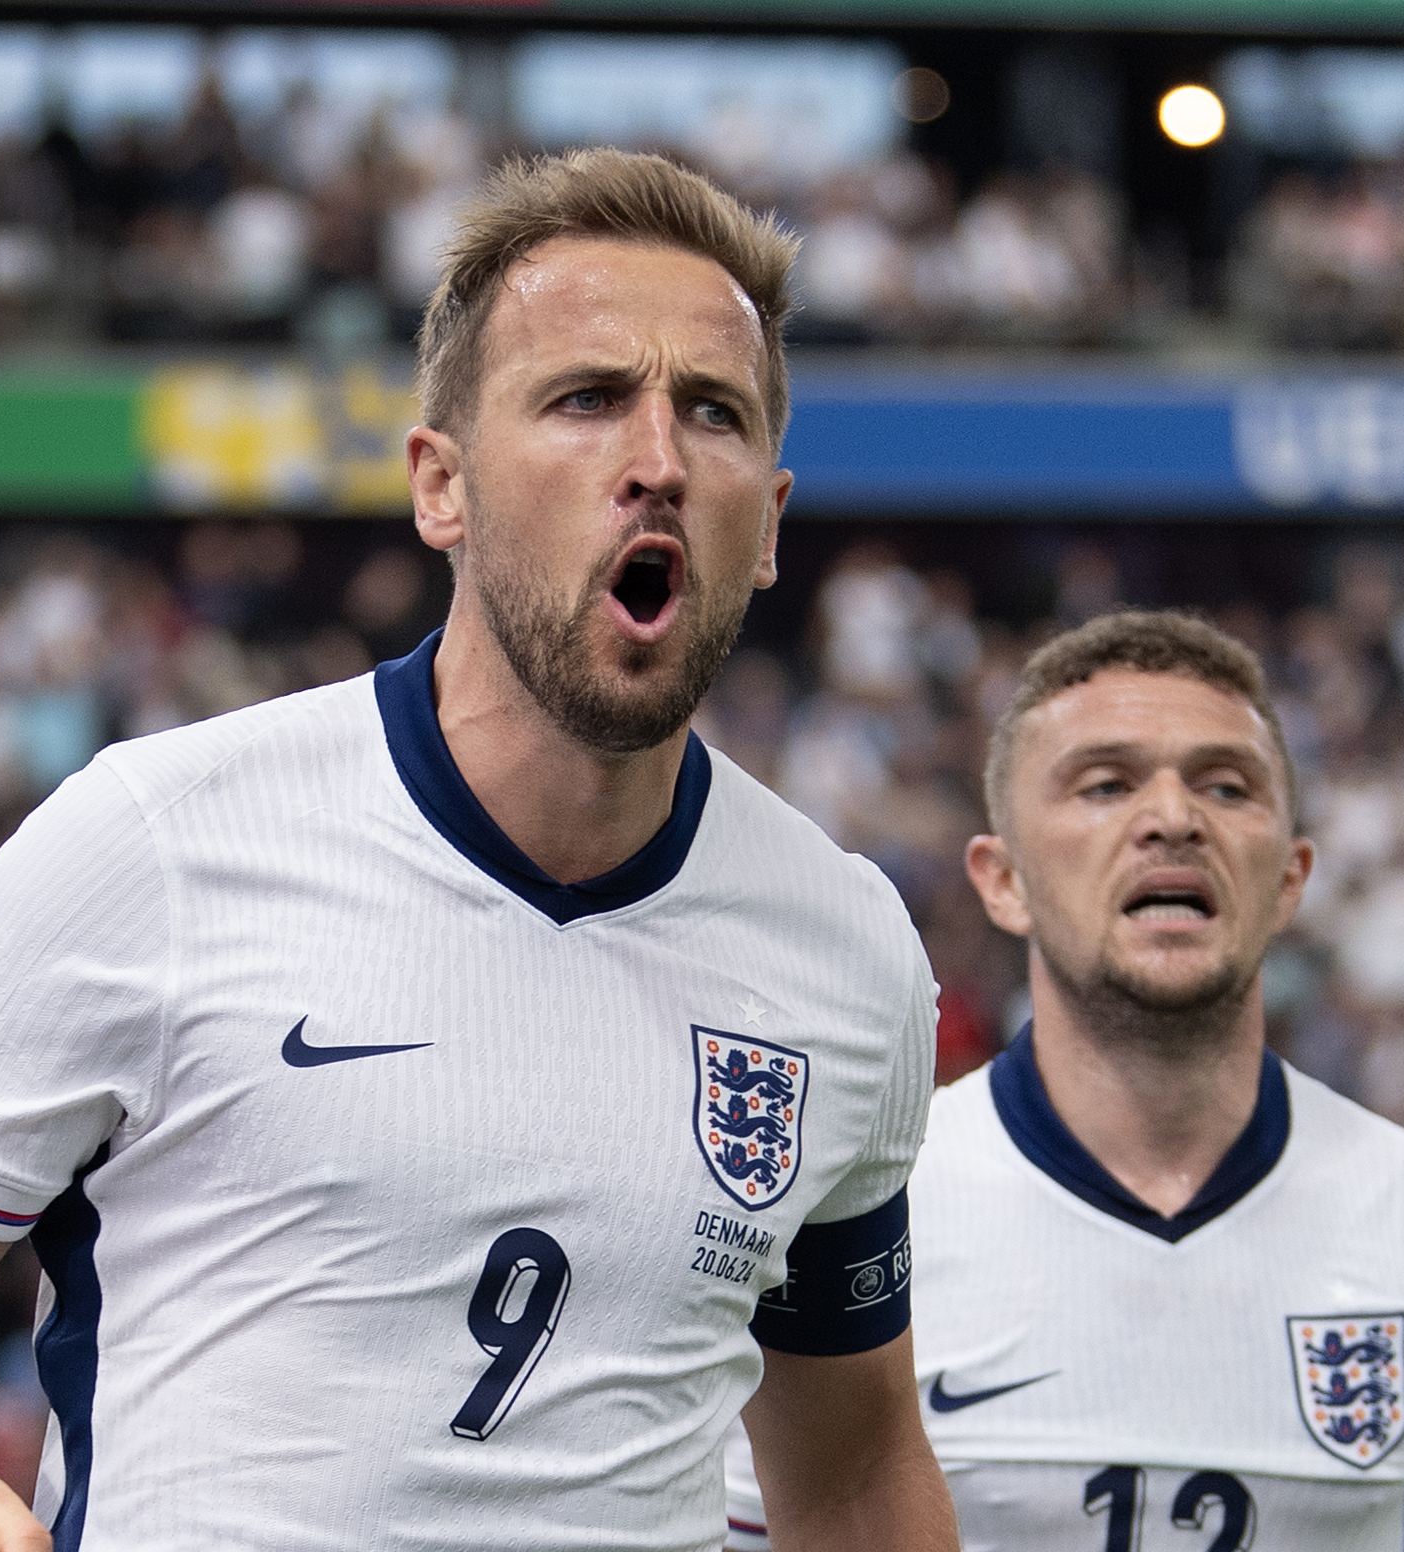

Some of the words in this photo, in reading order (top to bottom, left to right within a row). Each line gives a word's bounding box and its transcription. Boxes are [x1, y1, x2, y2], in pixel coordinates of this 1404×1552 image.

[694, 1211, 777, 1258] DENMARK
[690, 1246, 758, 1285] 20.06.24
[450, 1227, 572, 1442] 9
